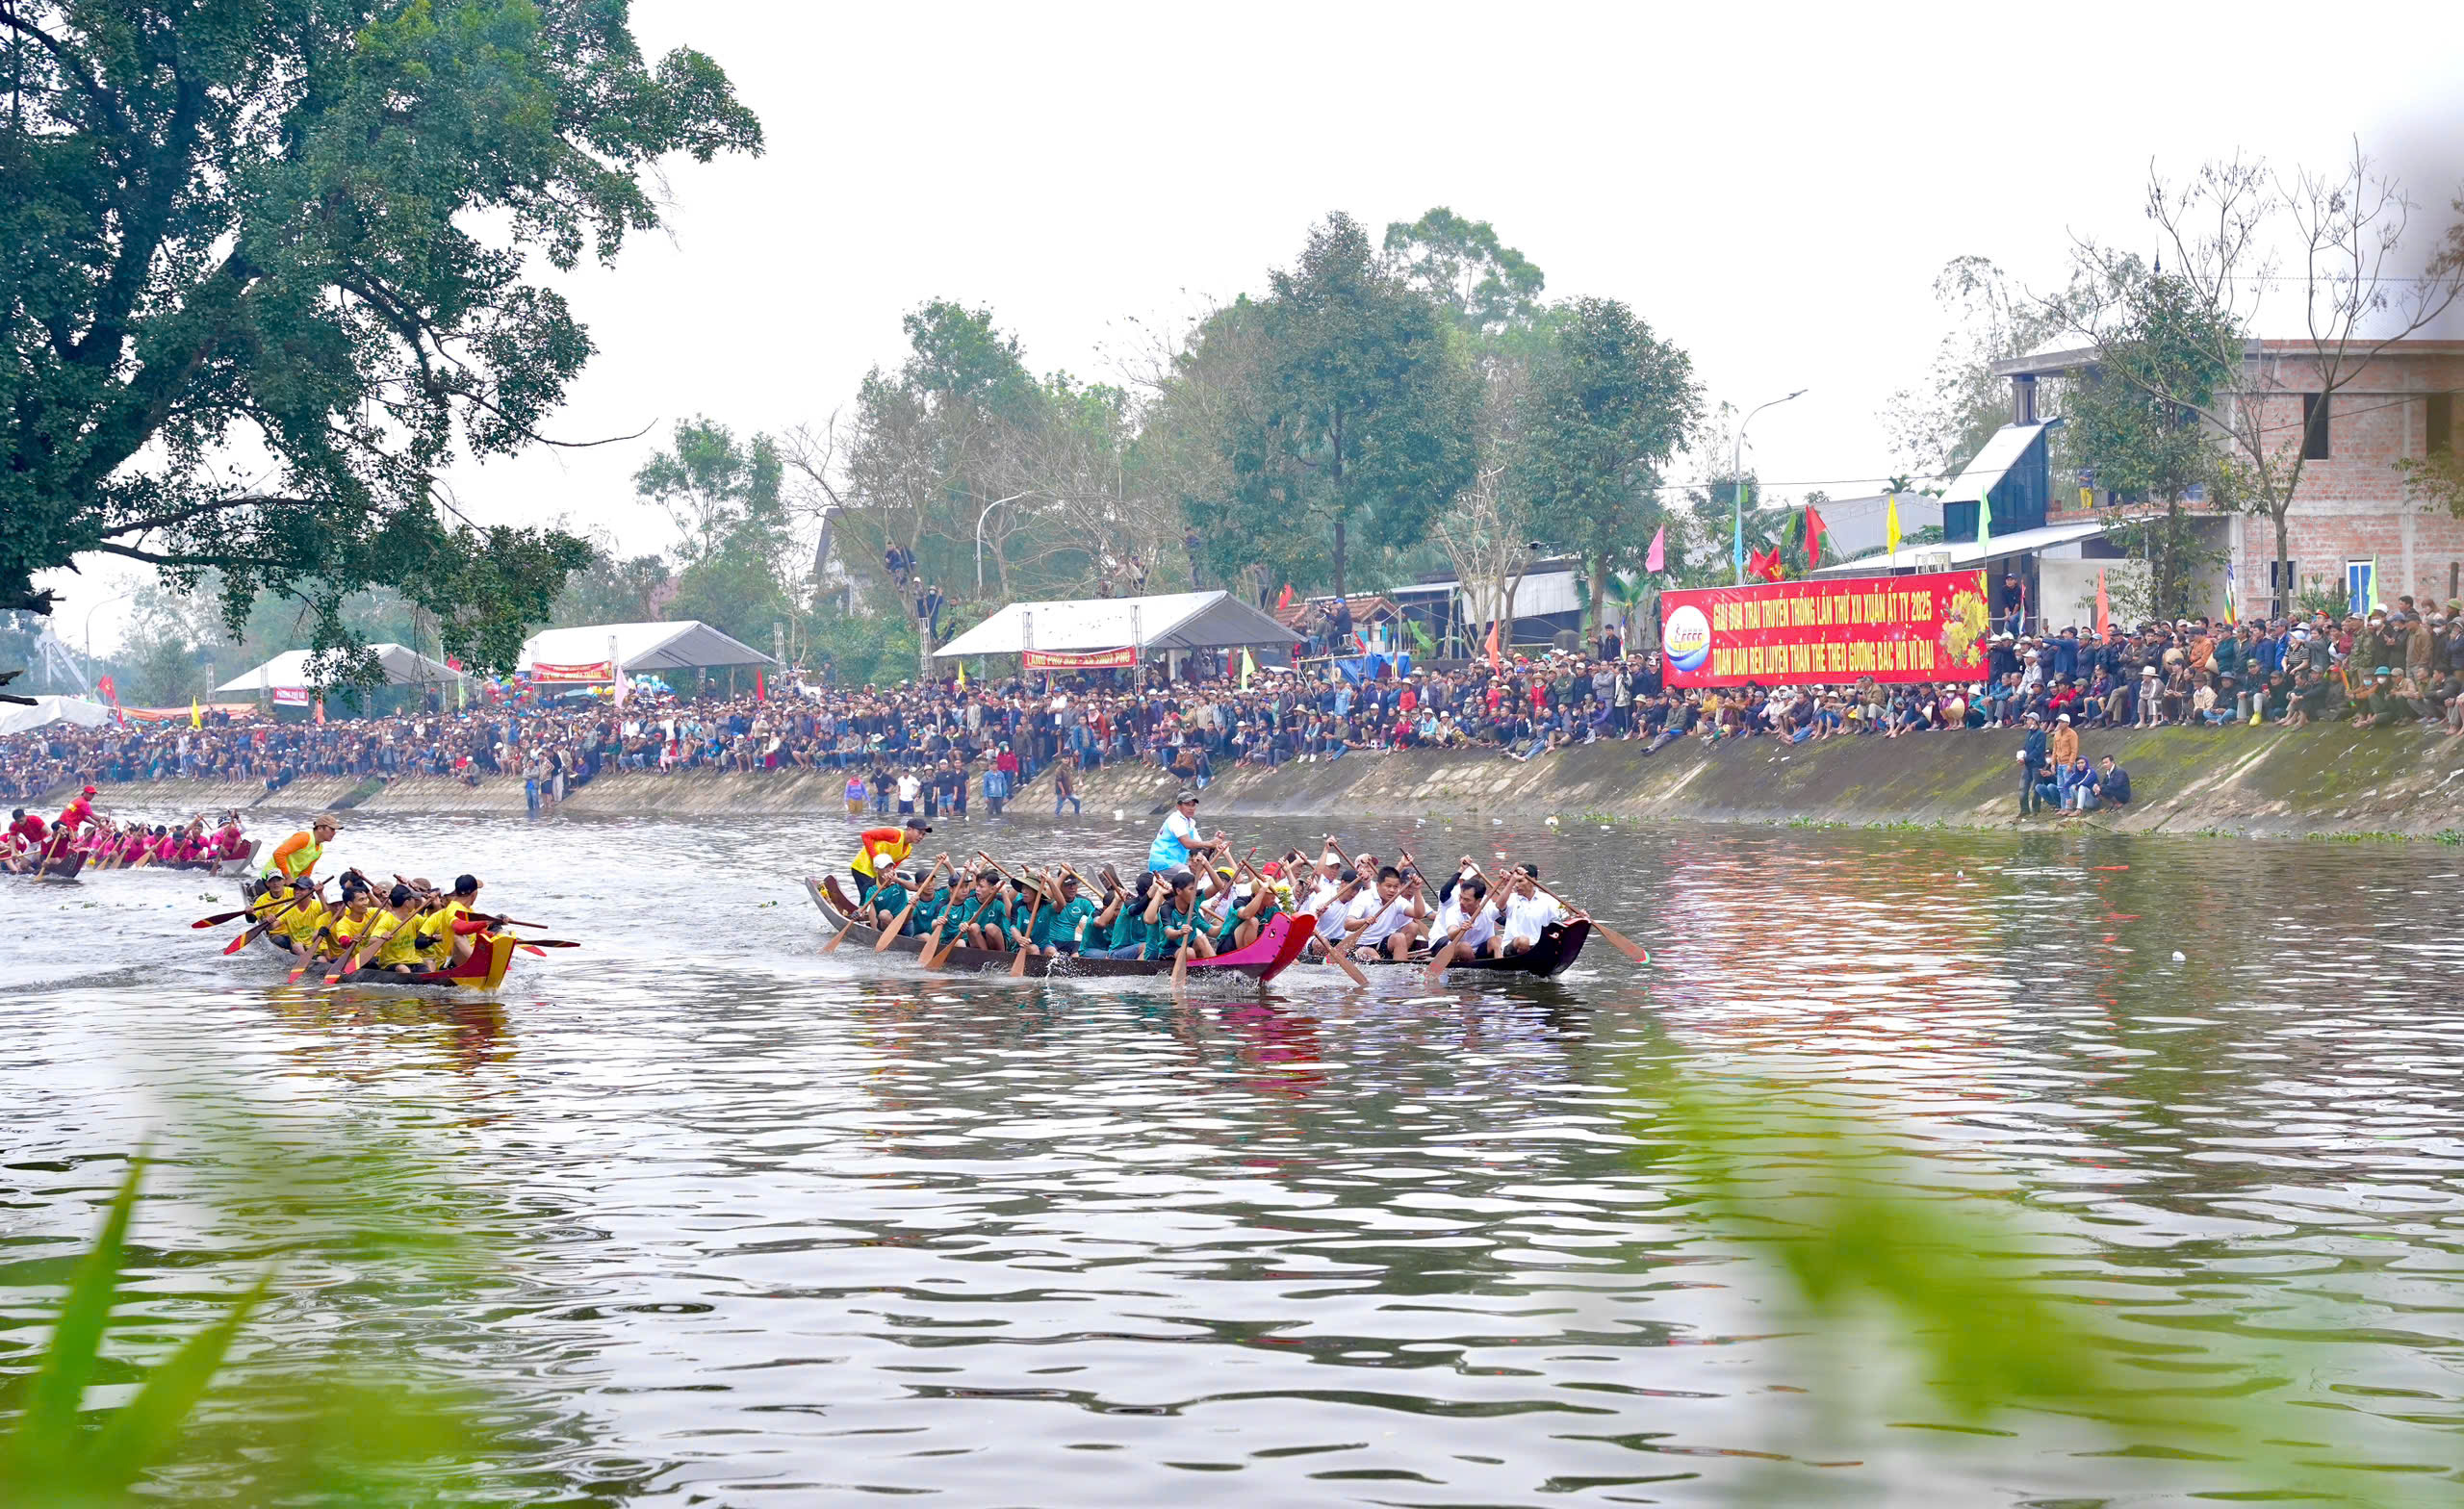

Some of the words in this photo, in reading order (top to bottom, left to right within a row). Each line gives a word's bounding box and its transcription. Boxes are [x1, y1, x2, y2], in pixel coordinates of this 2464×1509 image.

[1790, 587, 1815, 626] THỐNG
[1817, 585, 1833, 626] LẦN
[1851, 595, 1861, 624] XII
[1912, 591, 1931, 622] 2025
[1790, 637, 1810, 674] THÂN
[1827, 642, 1846, 672] THEO
[1877, 635, 1894, 671] BÁC
